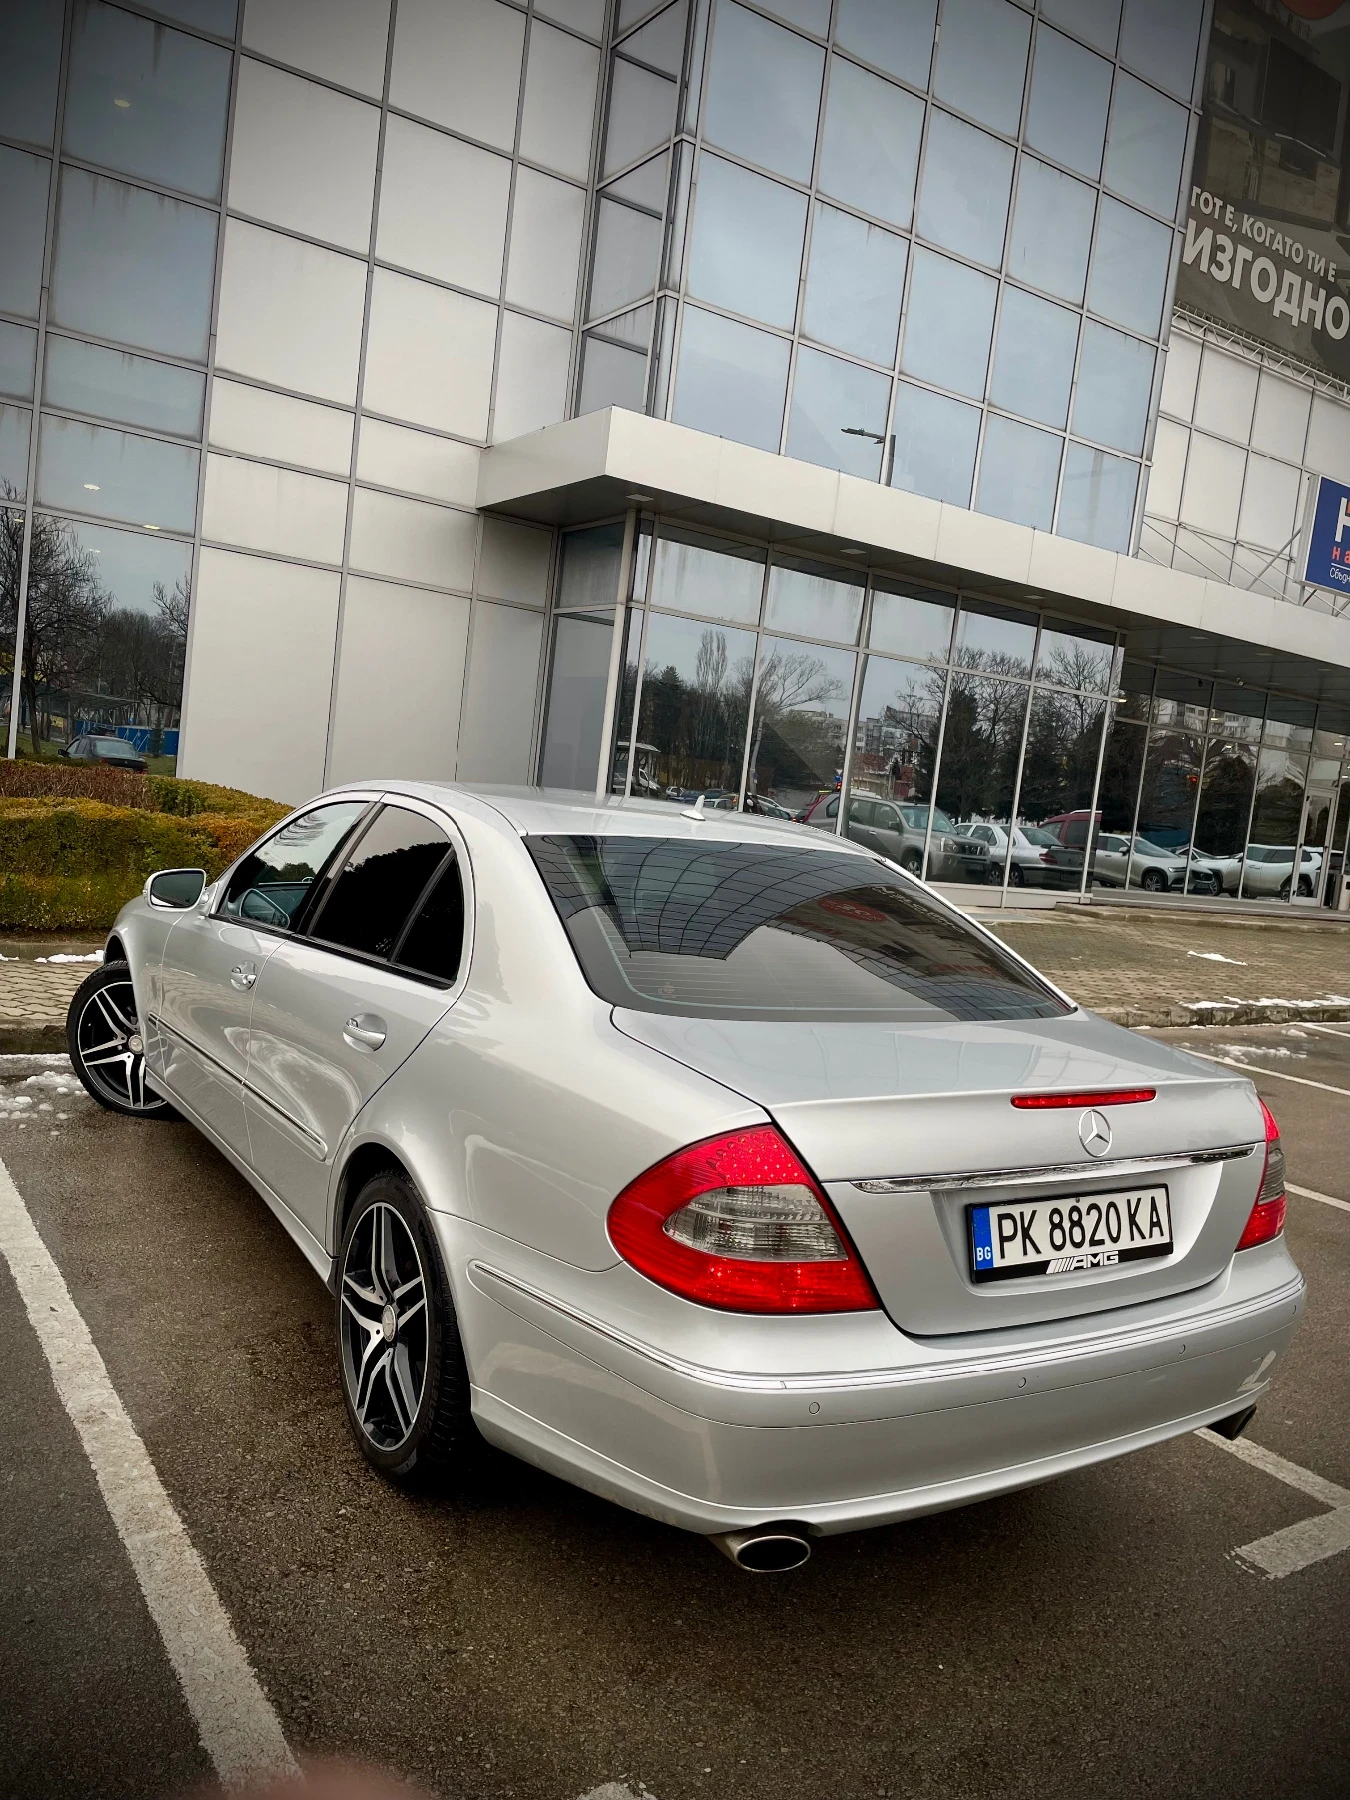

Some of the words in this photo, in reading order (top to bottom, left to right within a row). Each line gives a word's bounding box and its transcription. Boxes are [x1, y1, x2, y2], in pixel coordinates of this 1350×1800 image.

[1182, 217, 1350, 340] ИЗГОДНО
[1224, 204, 1239, 233] Е,
[1241, 213, 1304, 264] КОГАТО
[1307, 248, 1326, 277] ТИ
[1327, 262, 1337, 283] Е
[976, 1246, 992, 1262] BG
[997, 1209, 1042, 1260] PK
[1048, 1200, 1122, 1252] 8820
[1126, 1195, 1165, 1242] KA
